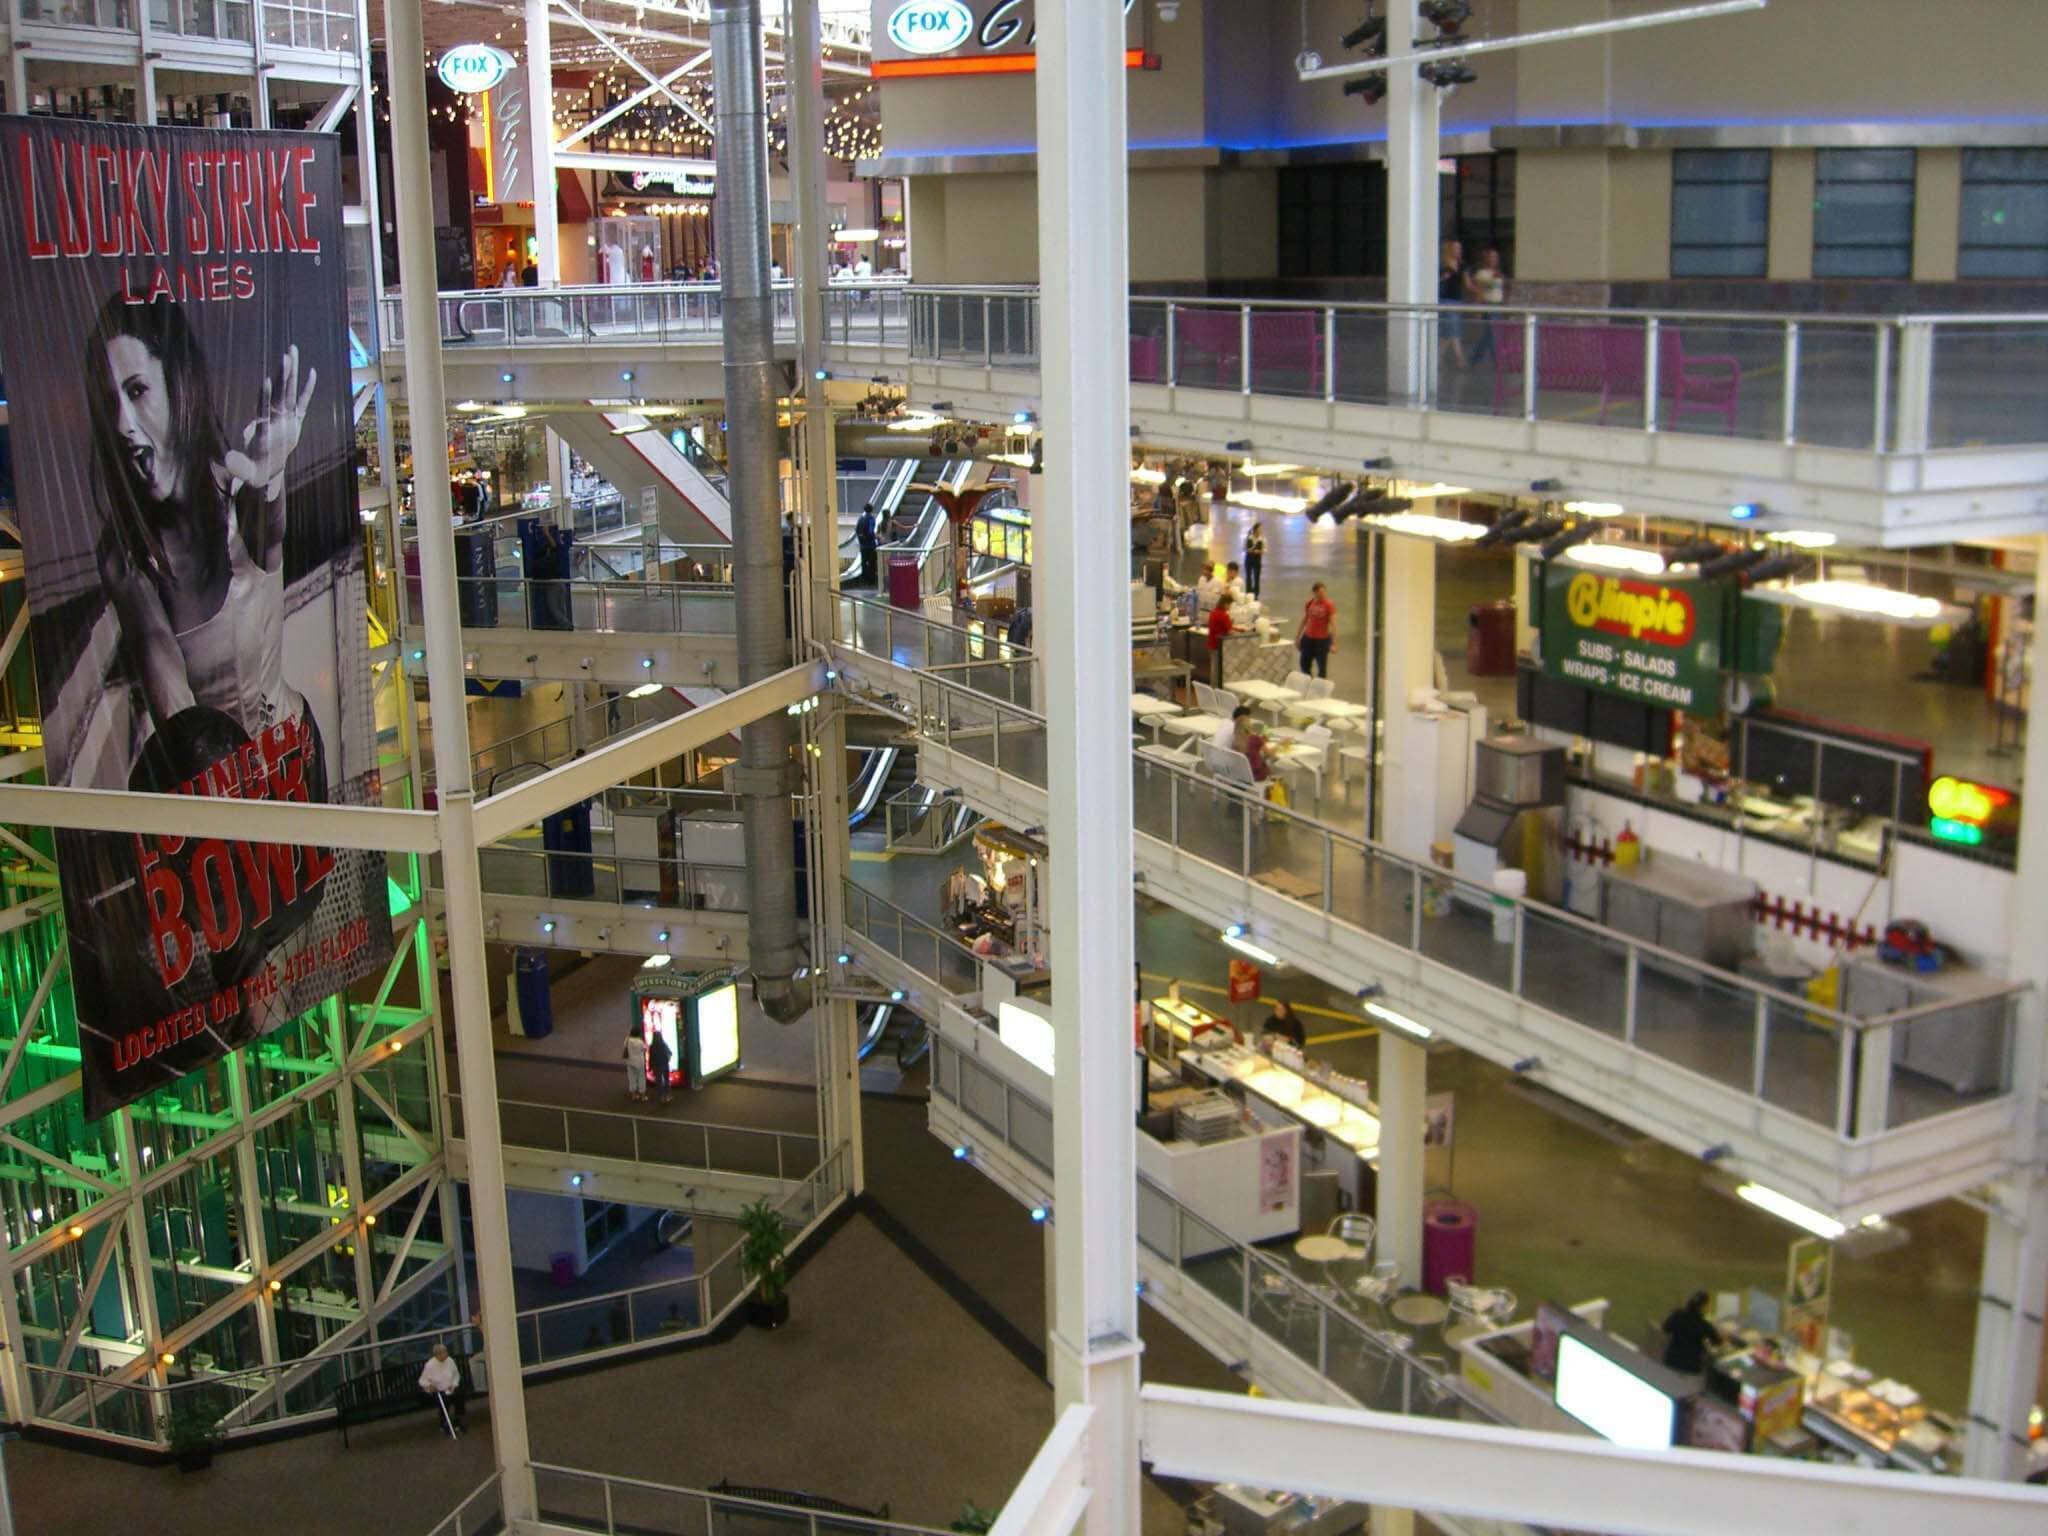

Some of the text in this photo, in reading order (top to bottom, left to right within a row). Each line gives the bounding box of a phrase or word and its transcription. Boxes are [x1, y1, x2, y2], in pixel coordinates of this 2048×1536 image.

[908, 10, 951, 33] FOX
[453, 56, 488, 75] FOX
[19, 132, 320, 260] LUCKY STRIKE
[119, 263, 256, 305] LANES
[1568, 572, 1686, 638] Blimpie
[1563, 658, 1692, 705] WRAPS ICE CREAM
[1578, 639, 1676, 678] SUBS SALADS
[142, 836, 336, 990] BOWL
[112, 916, 369, 1072] LOCATED ON THE 4TH FLOOR
